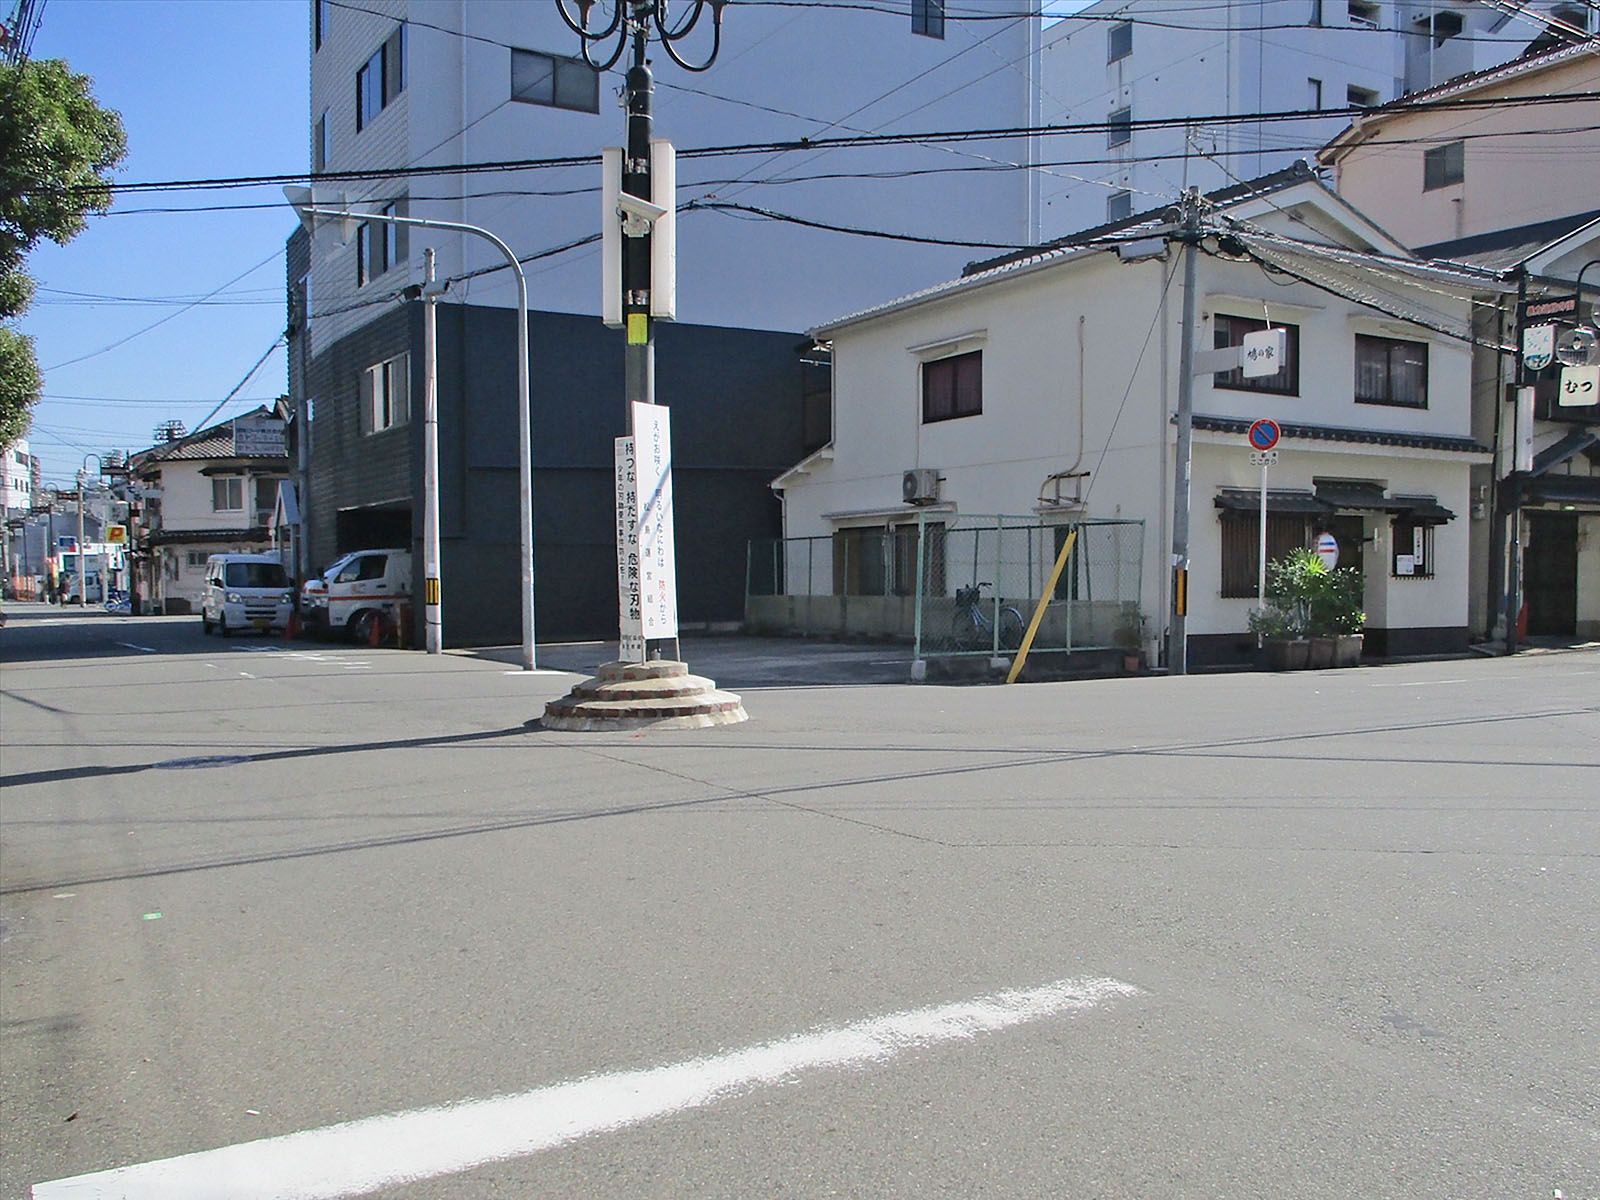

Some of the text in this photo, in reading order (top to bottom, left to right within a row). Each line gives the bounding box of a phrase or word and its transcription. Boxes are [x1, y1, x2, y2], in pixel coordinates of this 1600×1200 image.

[1565, 379, 1593, 394] むつ
[625, 442, 636, 484] 持つな
[626, 491, 638, 545] 持たすな
[627, 552, 640, 620] 危険な刃物
